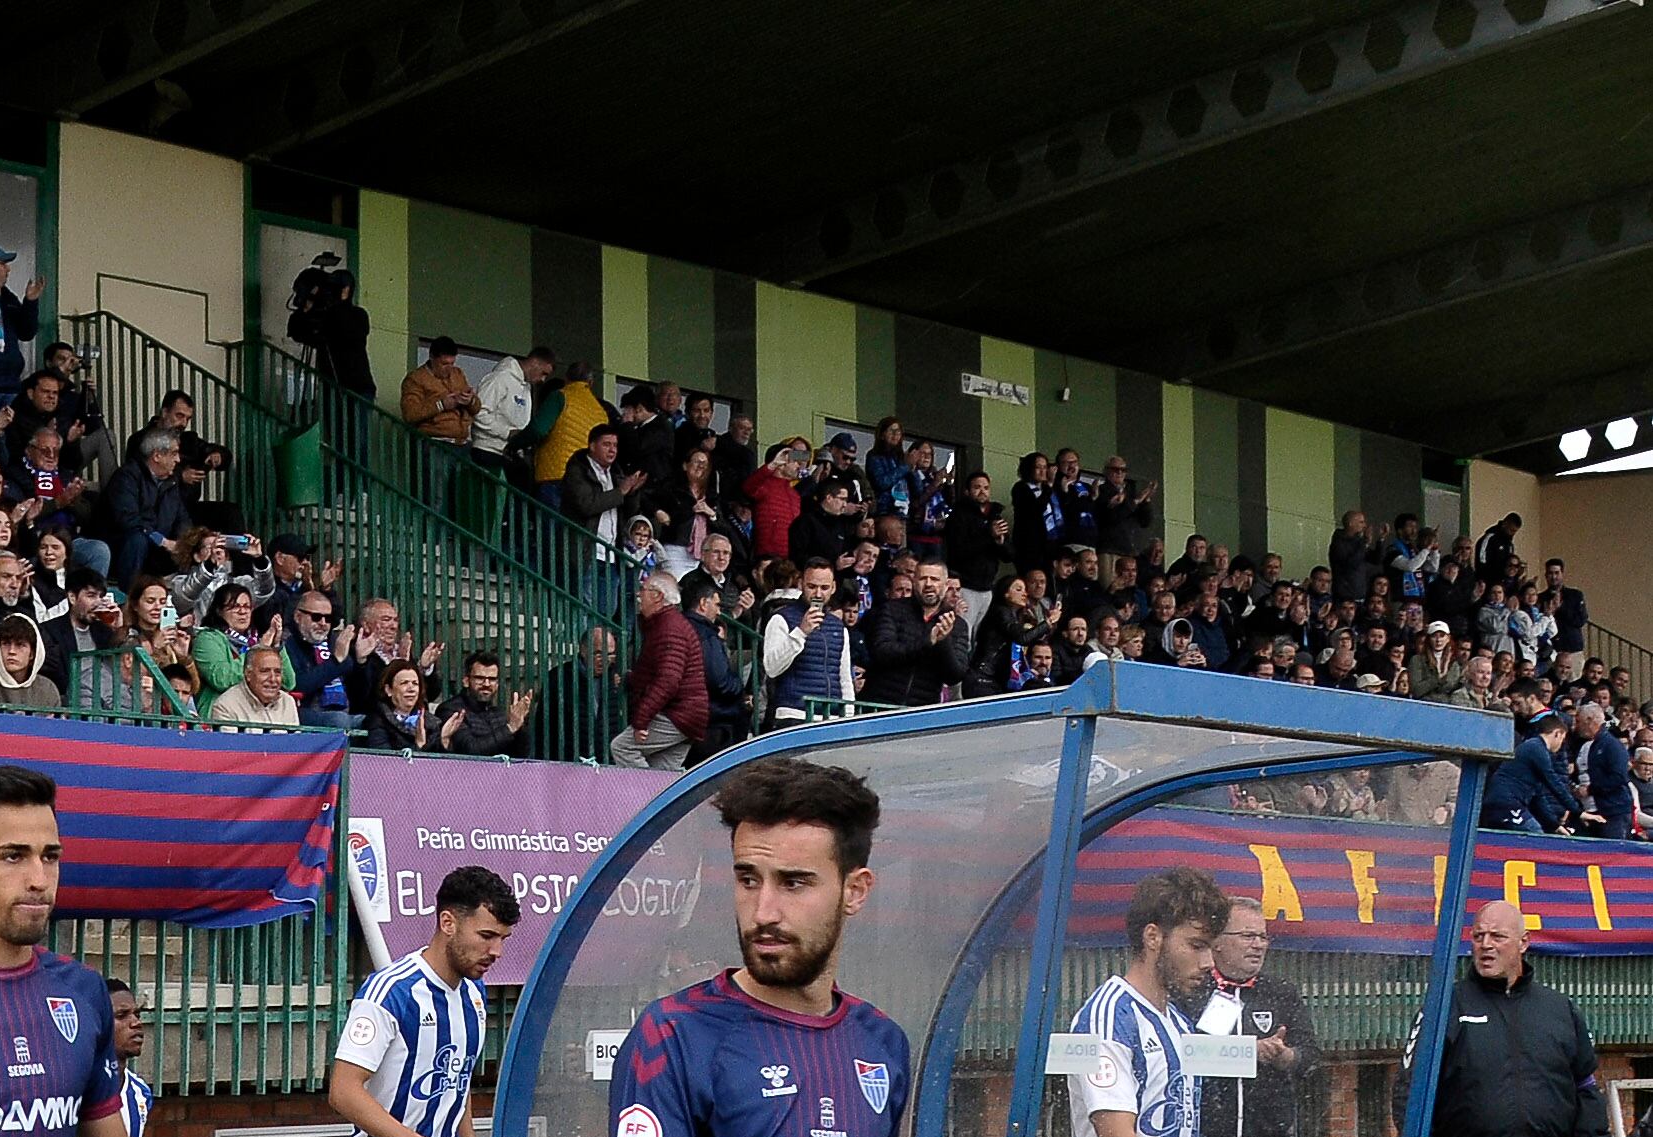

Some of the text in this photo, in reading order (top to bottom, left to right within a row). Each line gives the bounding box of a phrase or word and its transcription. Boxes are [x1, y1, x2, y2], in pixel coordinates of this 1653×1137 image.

[416, 827, 465, 850] Peña
[470, 828, 570, 853] Gimnástica
[397, 870, 436, 917] EL
[7, 1062, 45, 1077] SEGOVIA
